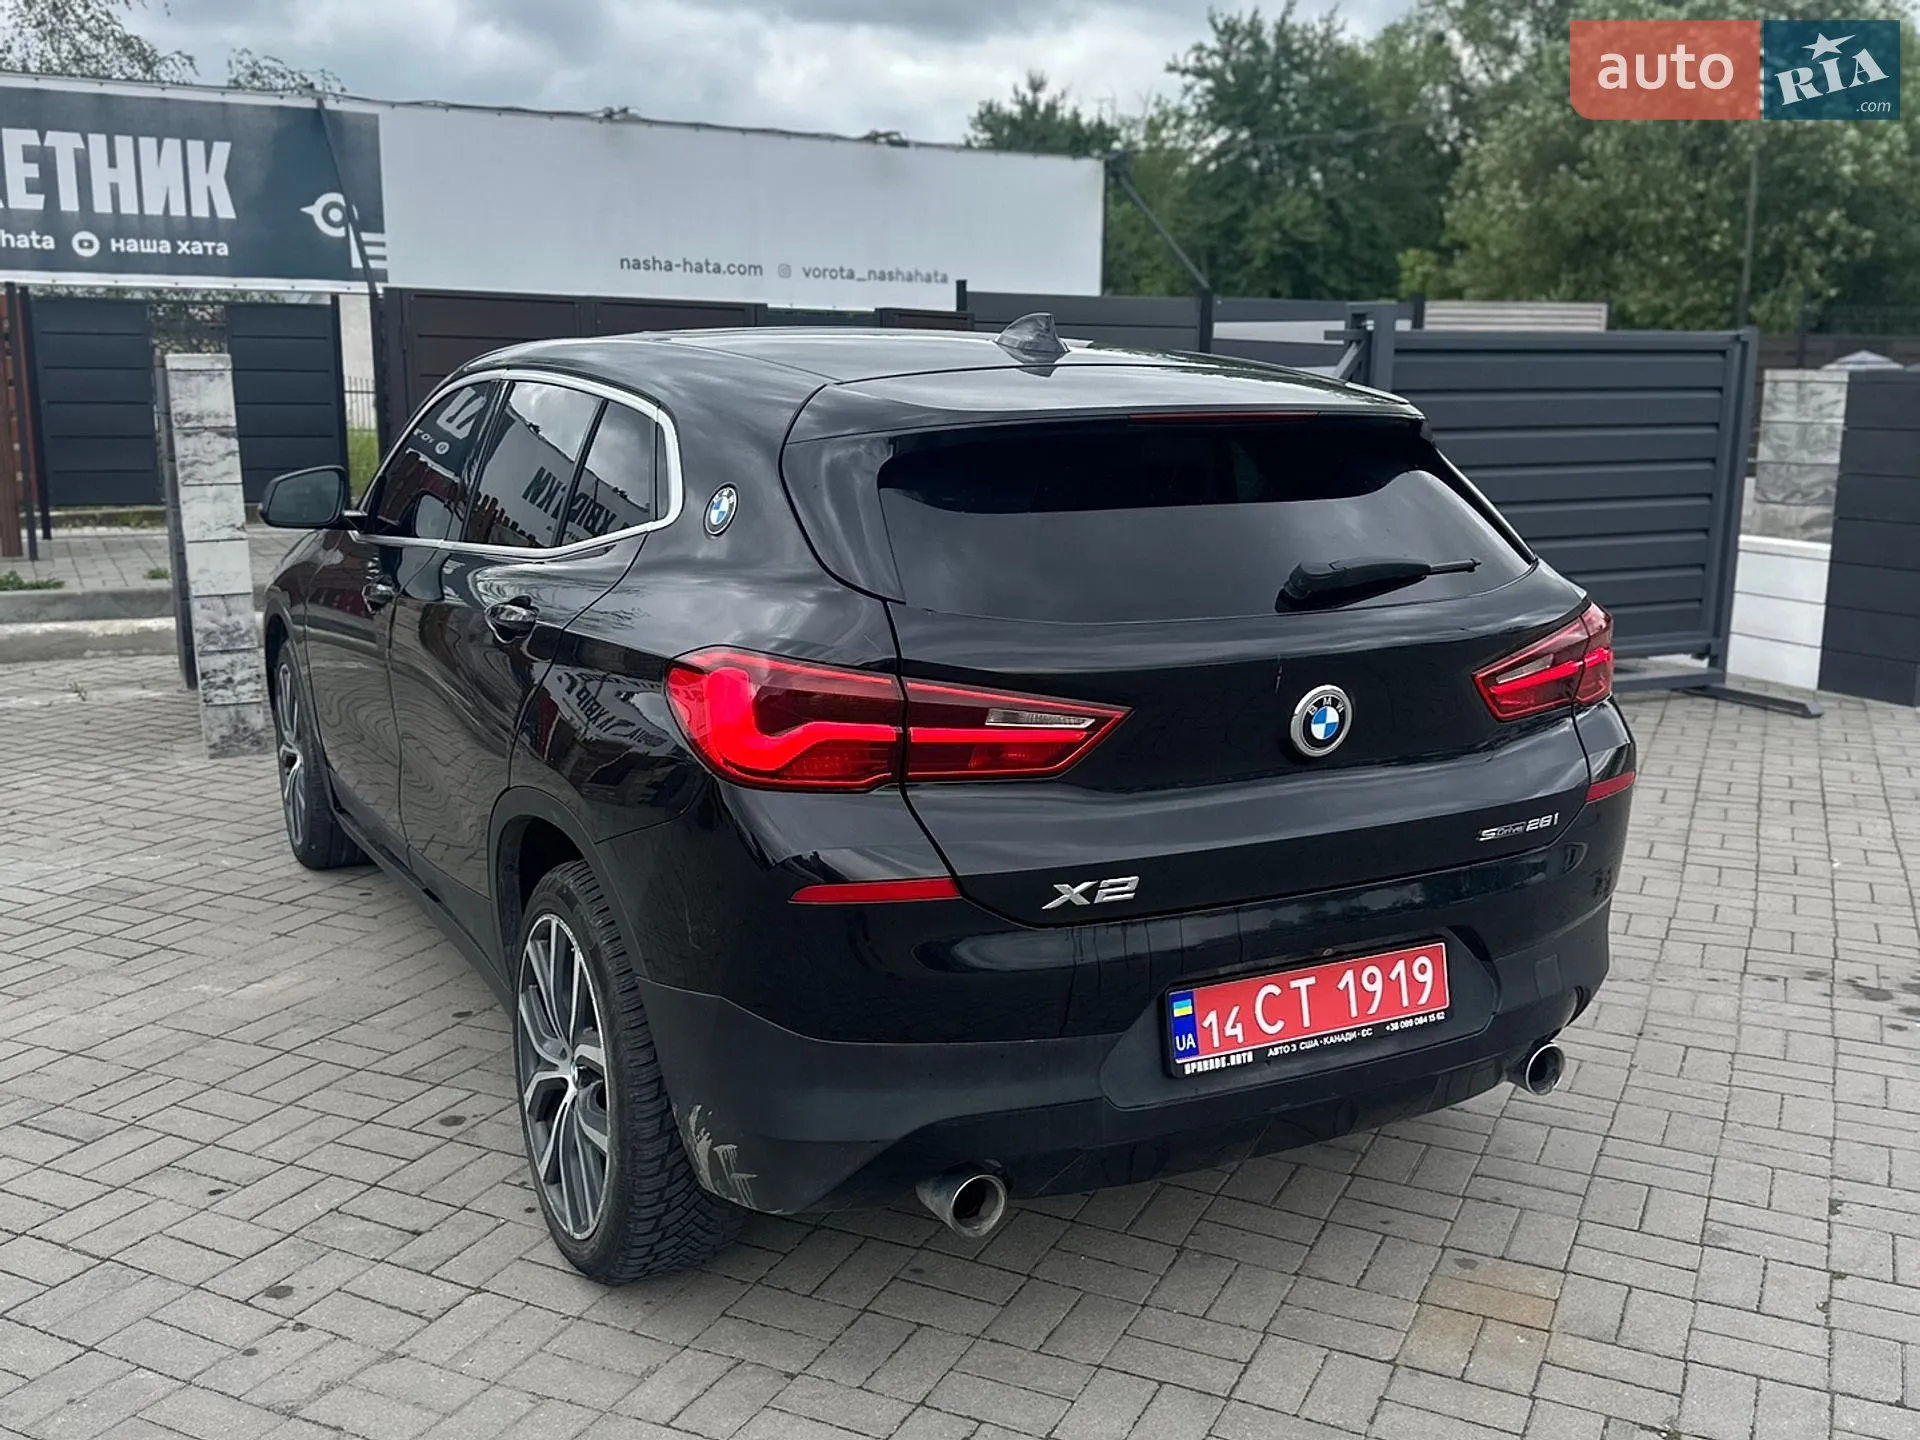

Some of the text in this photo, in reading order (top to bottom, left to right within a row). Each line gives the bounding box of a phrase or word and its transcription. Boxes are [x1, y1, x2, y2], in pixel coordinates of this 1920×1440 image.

[0, 127, 236, 219] ЕТНИК
[111, 237, 229, 257] наша хата
[619, 256, 763, 277] nasha-hata.com
[802, 264, 948, 285] vorota_nashahata
[1308, 697, 1345, 715] BMW
[1041, 875, 1140, 910] X2
[1202, 1005, 1244, 1049] 14
[1336, 955, 1434, 1019] 1919
[1175, 1033, 1197, 1052] UA
